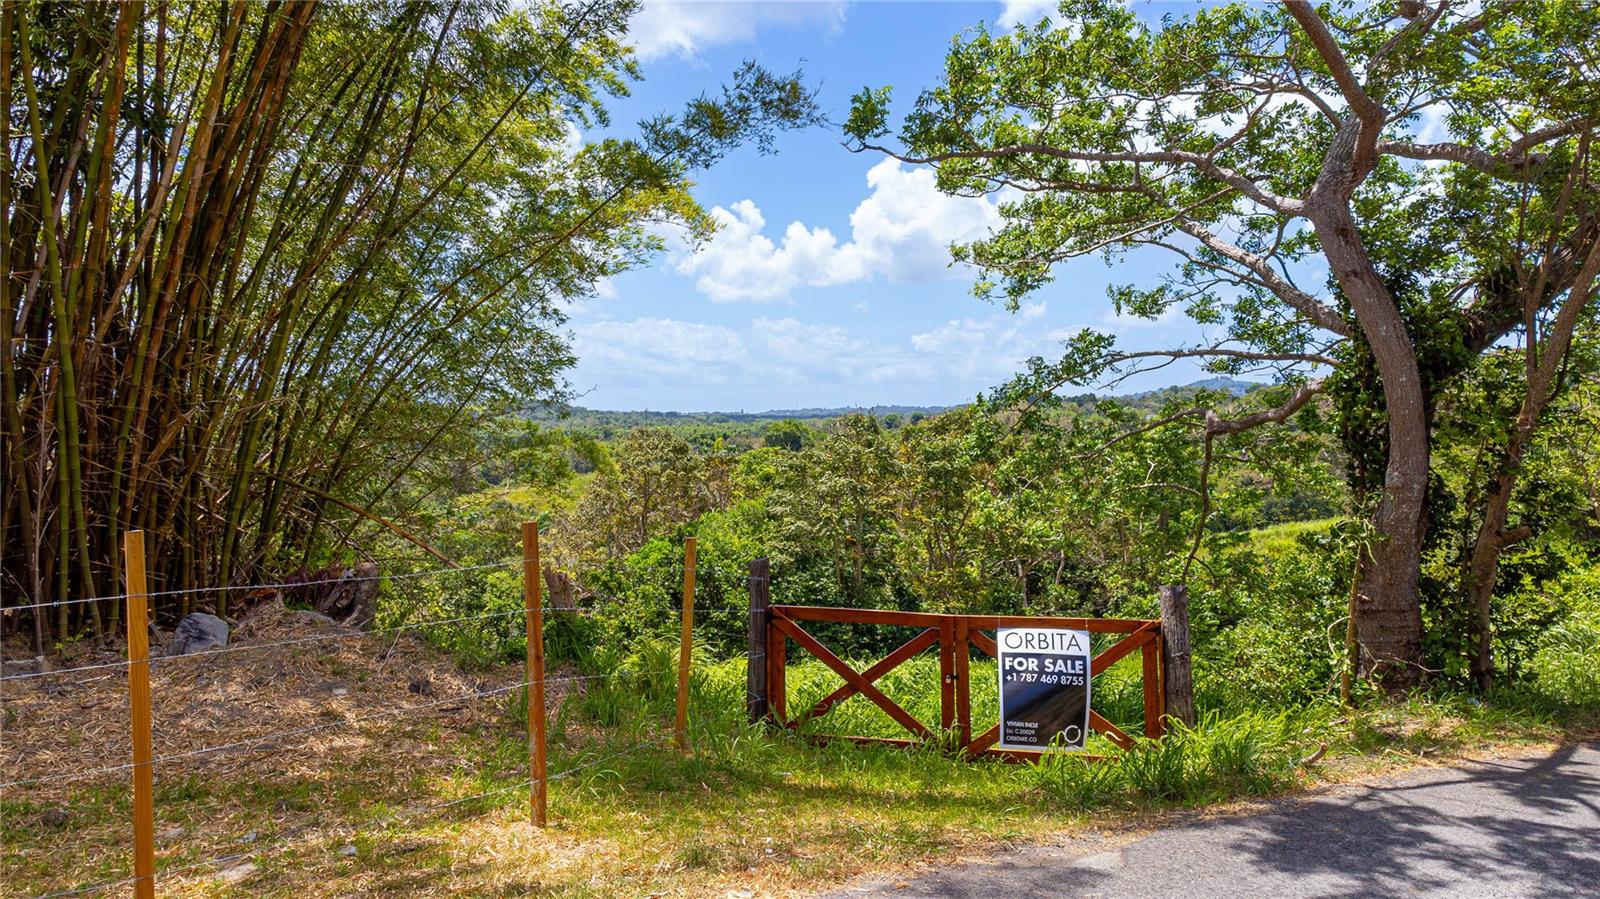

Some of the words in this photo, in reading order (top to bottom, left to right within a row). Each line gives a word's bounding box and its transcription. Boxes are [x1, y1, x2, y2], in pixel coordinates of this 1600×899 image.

[1005, 632, 1082, 652] ORBITA
[1005, 657, 1039, 671] FOR
[1044, 658, 1084, 674] SALE
[1020, 674, 1038, 682] 787
[1040, 676, 1058, 684] 469
[1060, 676, 1084, 686] 8755
